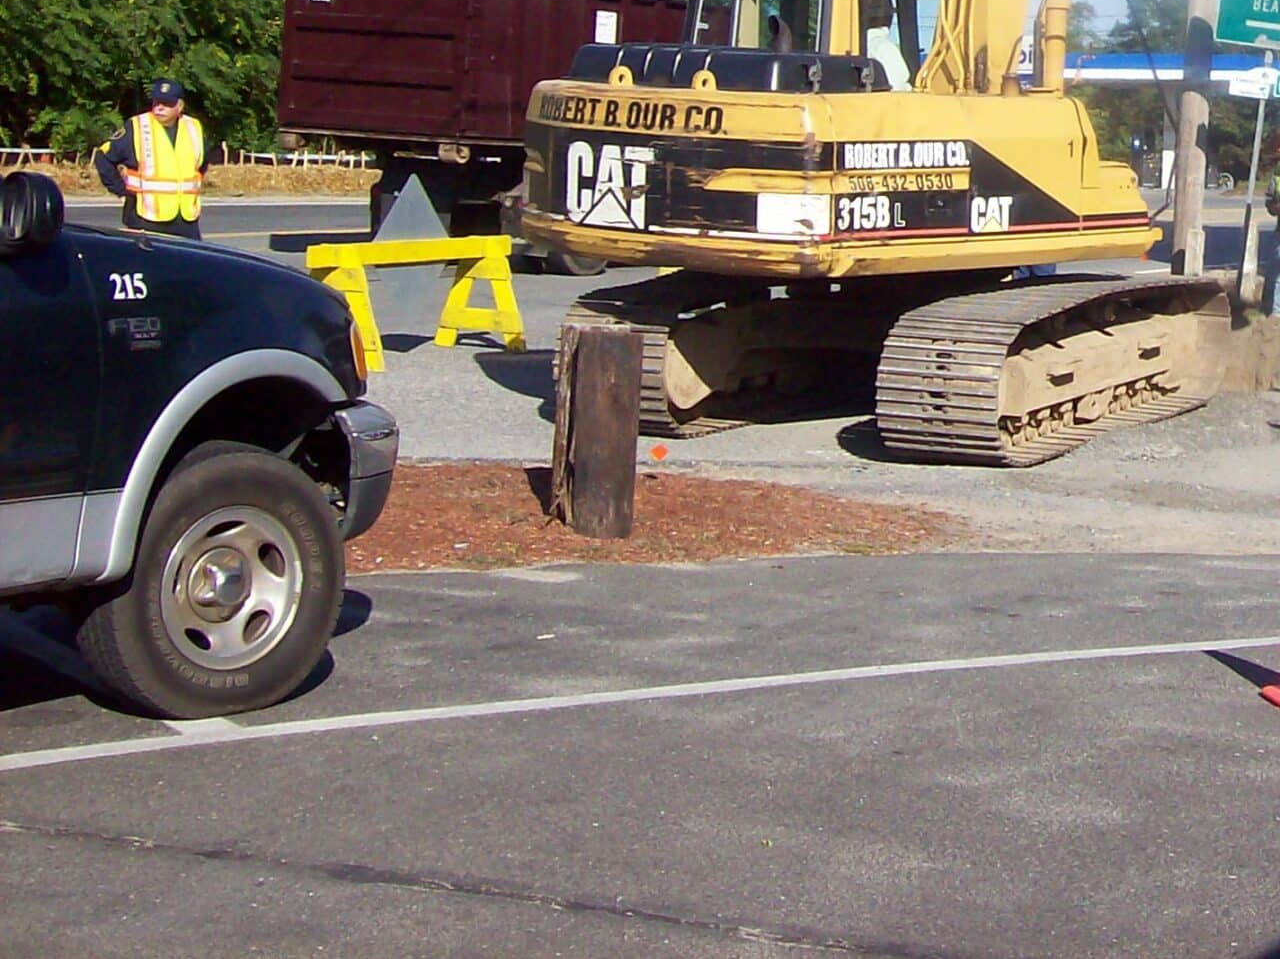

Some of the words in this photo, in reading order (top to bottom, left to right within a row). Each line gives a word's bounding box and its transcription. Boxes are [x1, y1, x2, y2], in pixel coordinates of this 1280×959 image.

[540, 95, 601, 125] ROBERT
[604, 100, 621, 128] B.
[626, 101, 676, 131] OUR
[684, 105, 728, 135] CO.
[844, 143, 898, 168] ROBERT
[899, 142, 912, 167] B.
[913, 142, 944, 167] OUR
[946, 141, 970, 167] CO.
[566, 141, 655, 229] CAT
[849, 172, 953, 191] 508-432-0530
[837, 195, 891, 230] 315B
[894, 202, 906, 228] L
[971, 196, 1013, 233] CAT
[109, 273, 148, 300] 215
